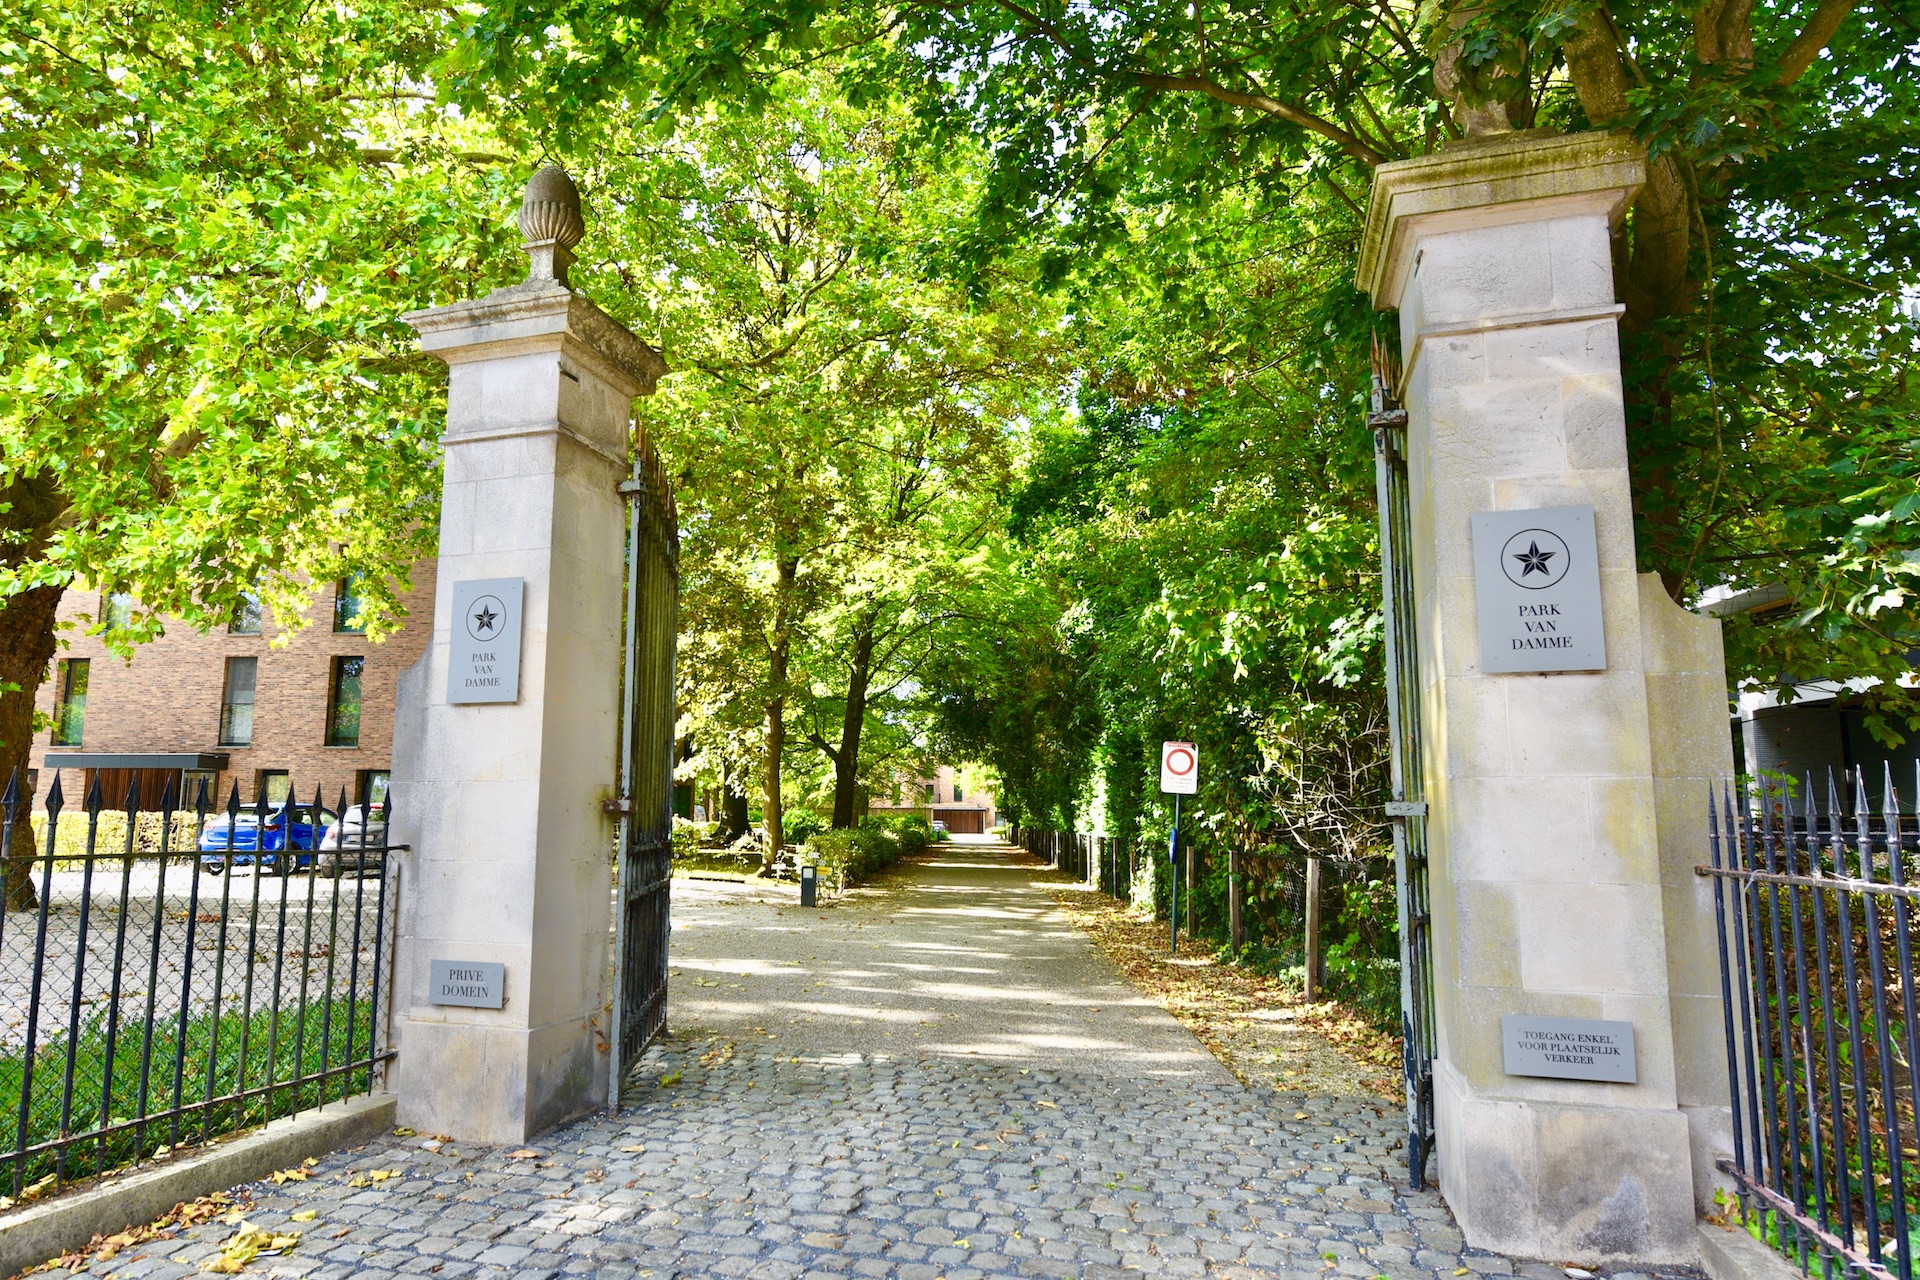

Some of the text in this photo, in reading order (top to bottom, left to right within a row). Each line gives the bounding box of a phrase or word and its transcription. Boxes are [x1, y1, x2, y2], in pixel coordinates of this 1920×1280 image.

[1518, 603, 1562, 617] PARK
[1524, 620, 1557, 633] VAN
[1511, 636, 1573, 650] DAMME
[472, 652, 497, 662] PARK
[474, 665, 493, 675] VAN
[465, 677, 500, 688] DAMME
[449, 968, 484, 982] PRIVE
[442, 984, 489, 998] DOMEIN
[1523, 1030, 1614, 1044] TOEGANG ENKEL
[1517, 1041, 1621, 1056] VOOR PLAATSELIJK
[1544, 1053, 1595, 1065] VERKEER
